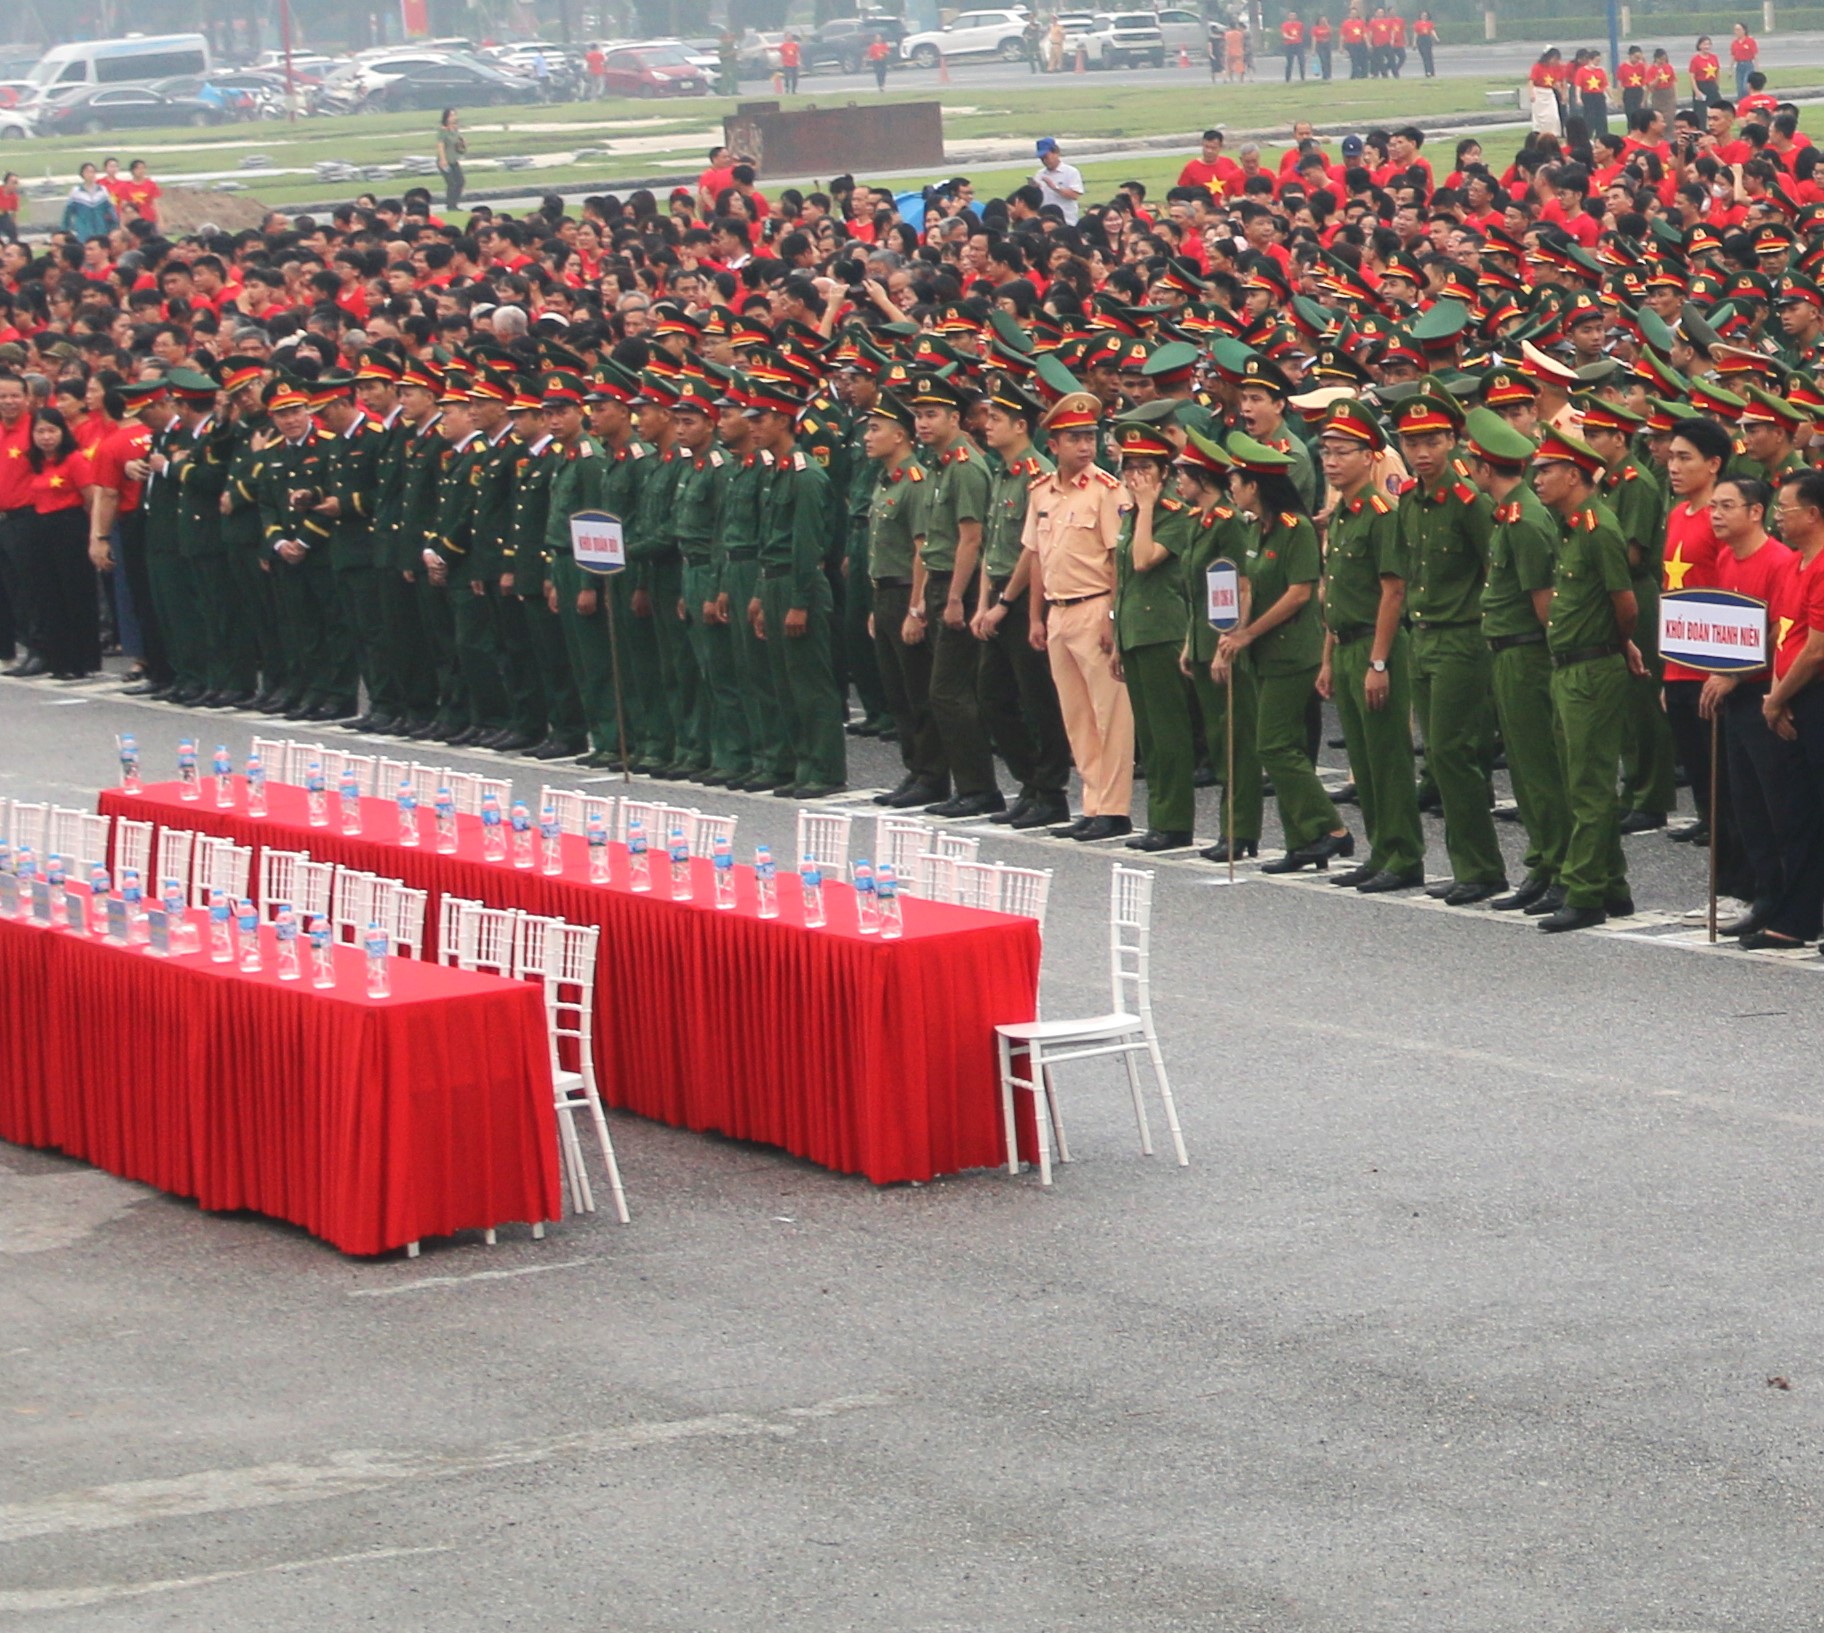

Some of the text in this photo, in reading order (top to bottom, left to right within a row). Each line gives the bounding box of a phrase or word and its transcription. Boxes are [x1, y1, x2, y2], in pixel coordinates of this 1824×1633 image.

[1665, 614, 1760, 648] KHỐI ĐOÀN THANH NIÊN
